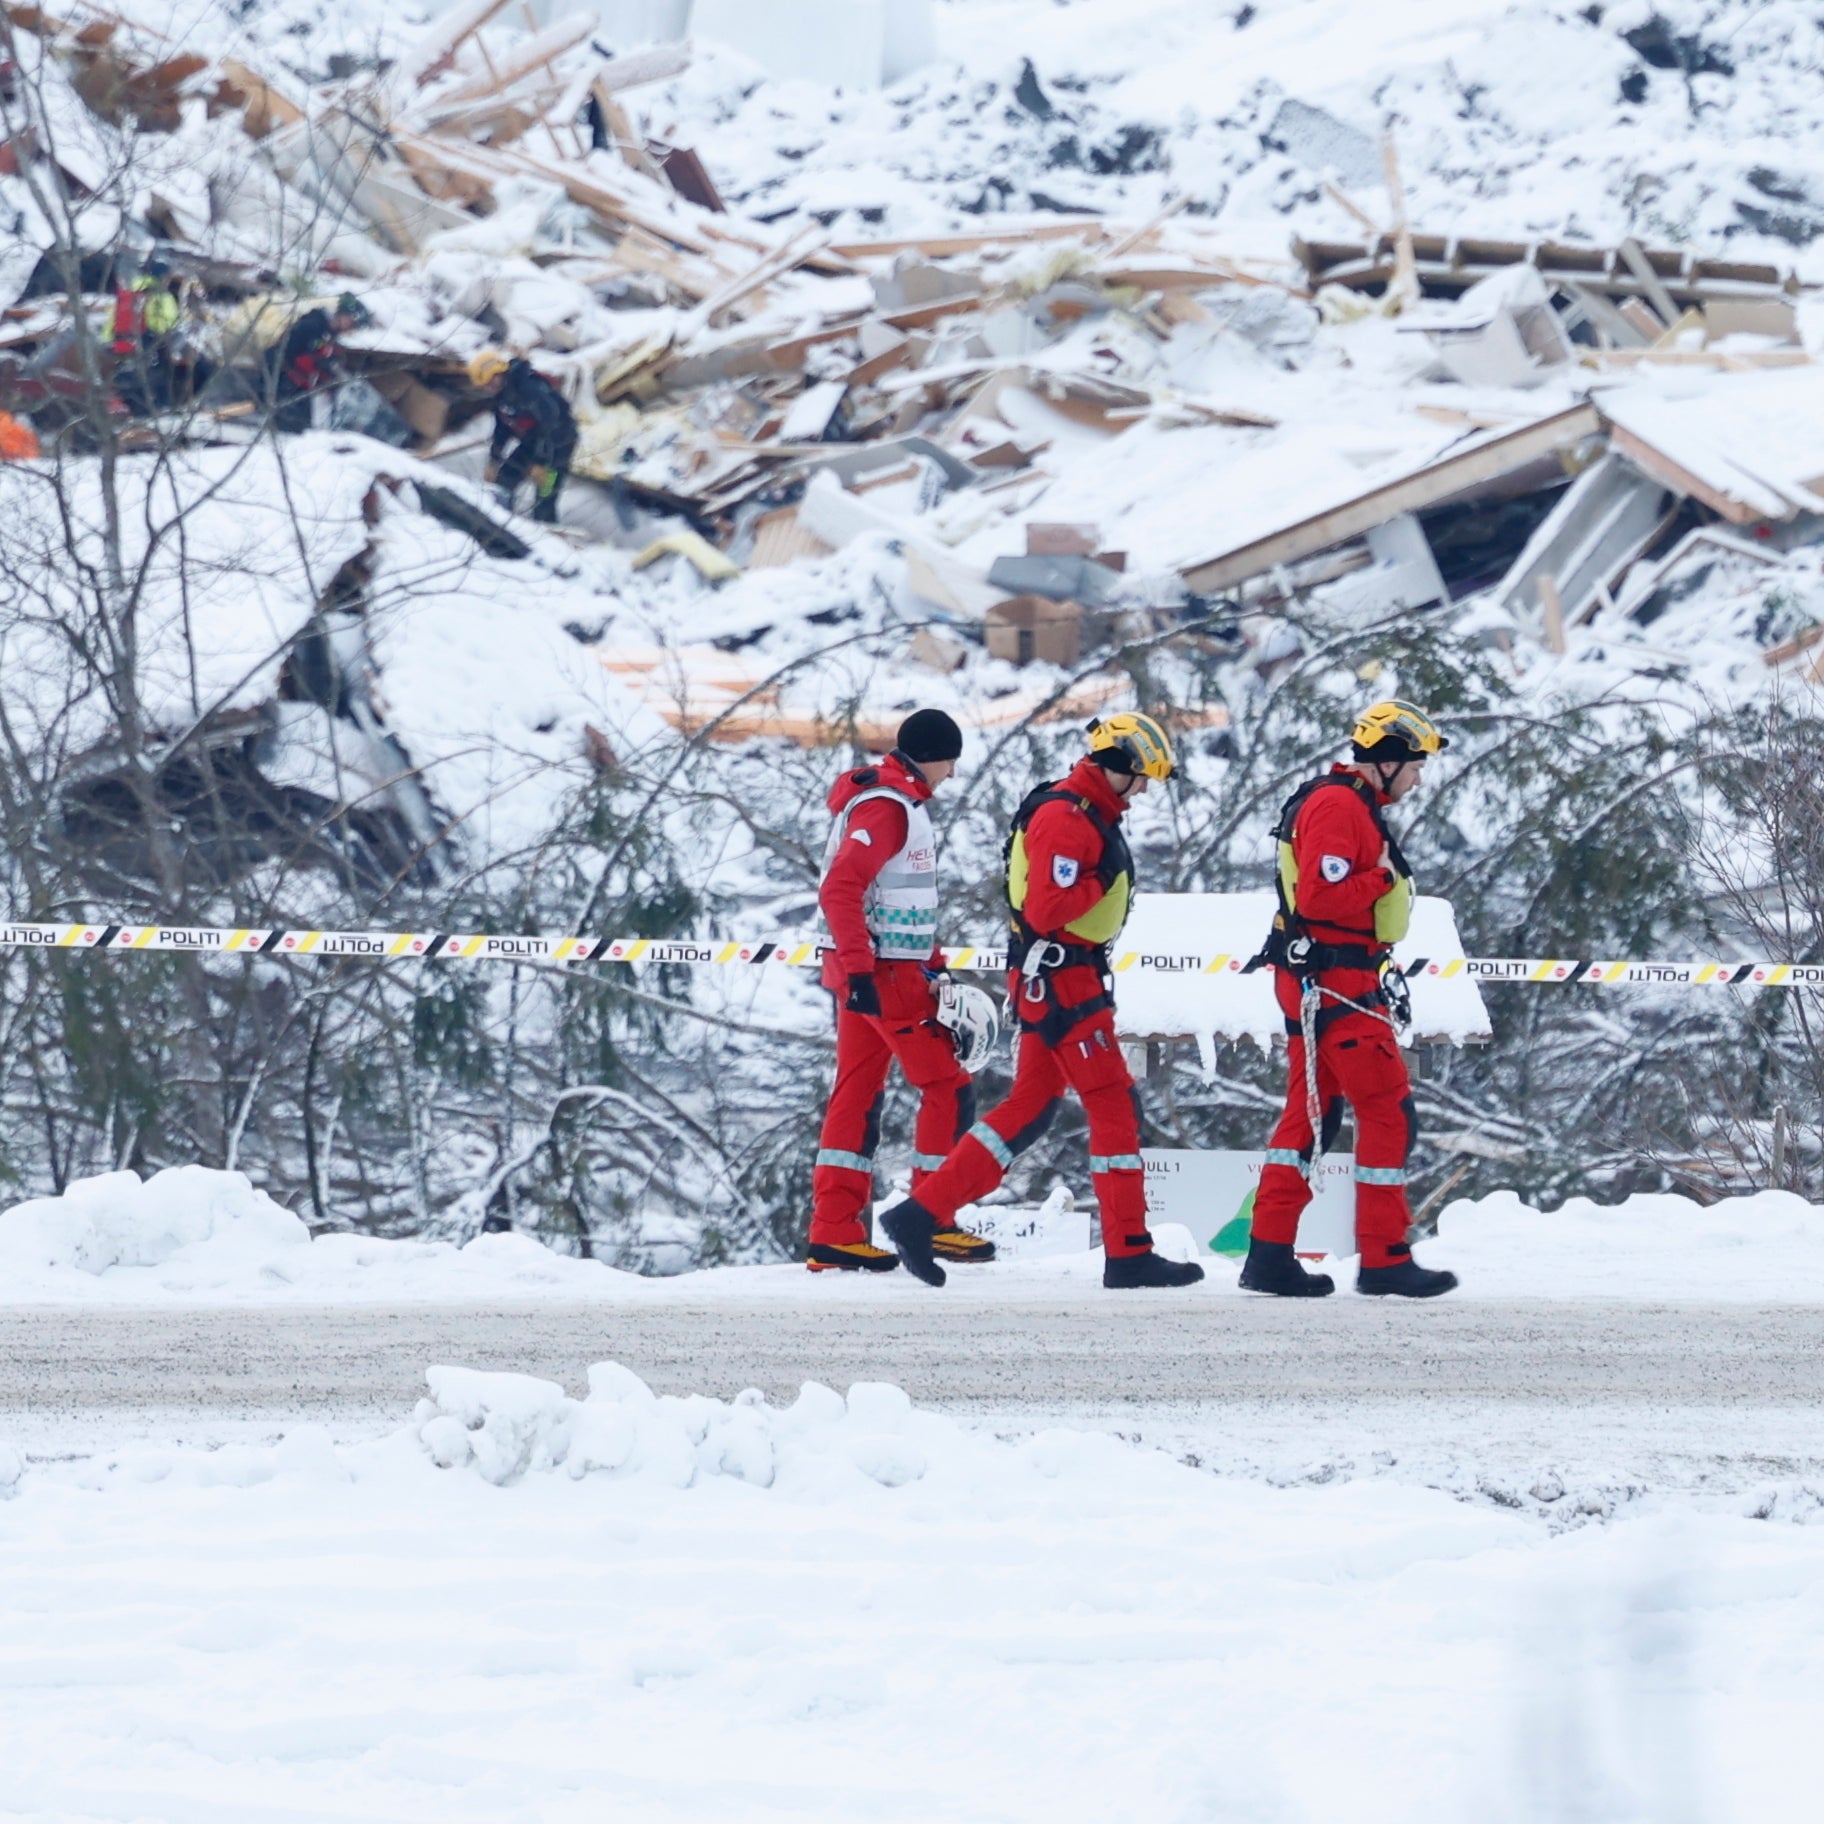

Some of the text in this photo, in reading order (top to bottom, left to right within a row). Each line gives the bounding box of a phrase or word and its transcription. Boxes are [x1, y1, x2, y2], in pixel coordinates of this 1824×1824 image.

[160, 931, 220, 944] POLITI
[324, 939, 384, 952] POLITI
[488, 941, 548, 954] POLITI
[651, 948, 711, 961] POLITI
[1141, 956, 1201, 968] POLITI
[1467, 963, 1527, 975] POLITI
[1630, 969, 1689, 981] POLITI
[1175, 1162, 1180, 1173] 1
